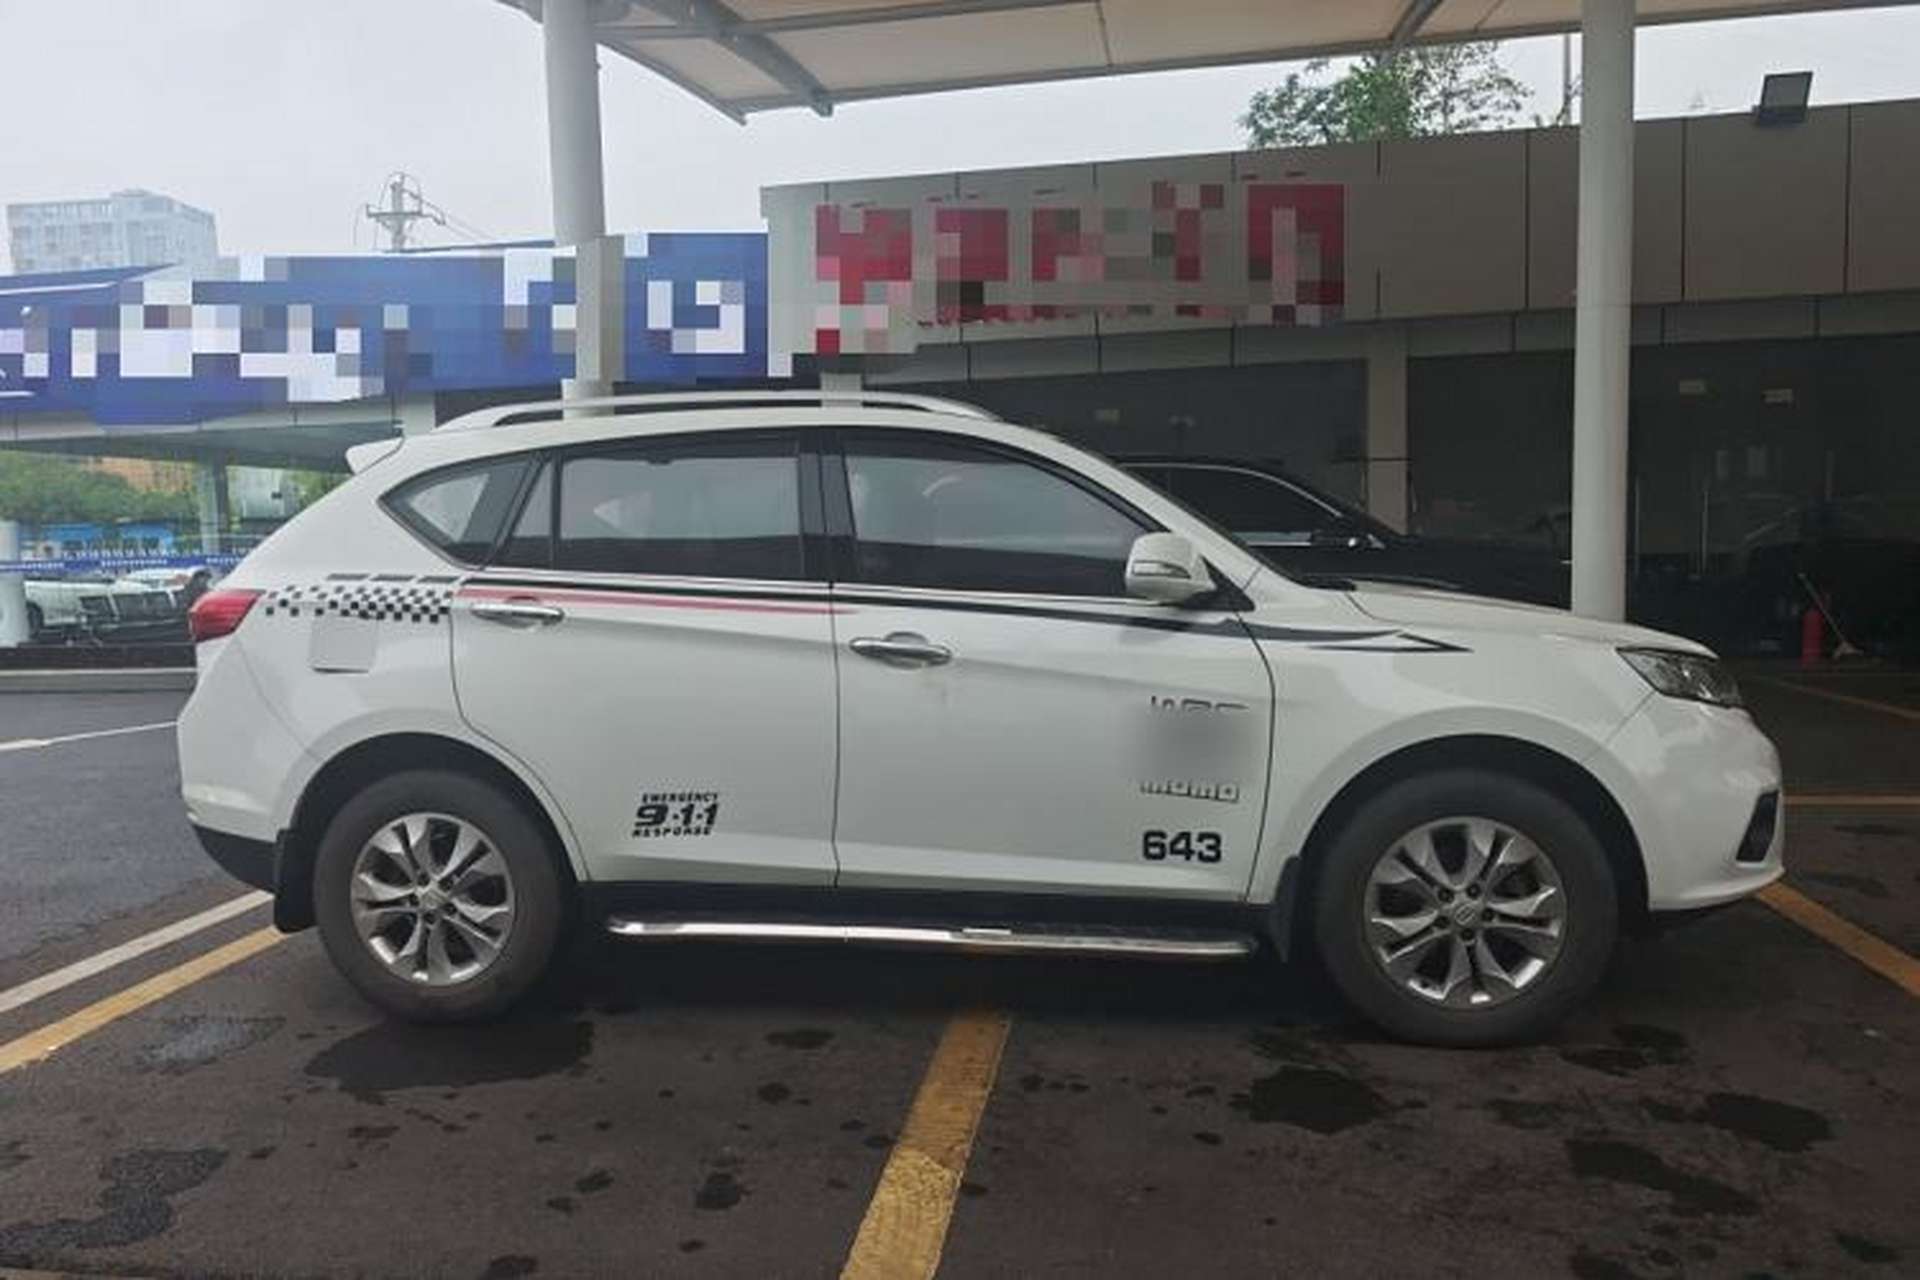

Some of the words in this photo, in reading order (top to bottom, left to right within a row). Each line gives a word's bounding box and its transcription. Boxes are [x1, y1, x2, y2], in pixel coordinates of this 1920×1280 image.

[642, 792, 718, 802] EMERGENCY
[632, 827, 711, 837] RESPONSE
[1142, 830, 1222, 863] 643
